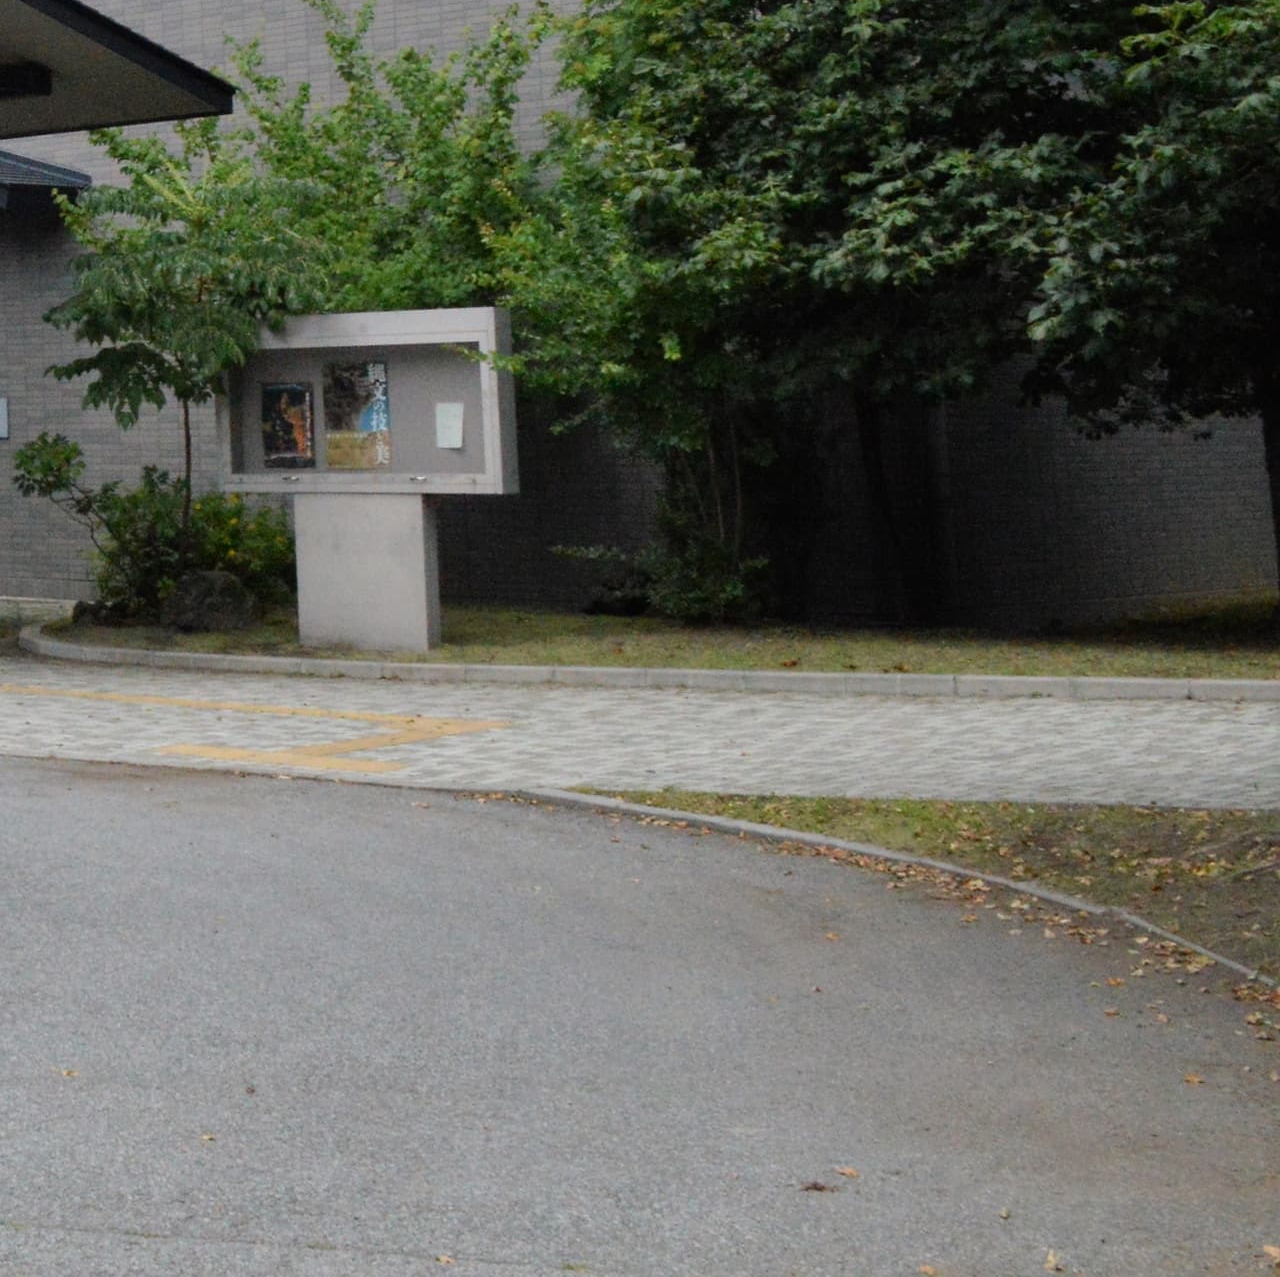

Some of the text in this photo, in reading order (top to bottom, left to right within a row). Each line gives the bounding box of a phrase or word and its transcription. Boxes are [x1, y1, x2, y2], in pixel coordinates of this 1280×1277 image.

[367, 362, 390, 466] 縄文の技と美
